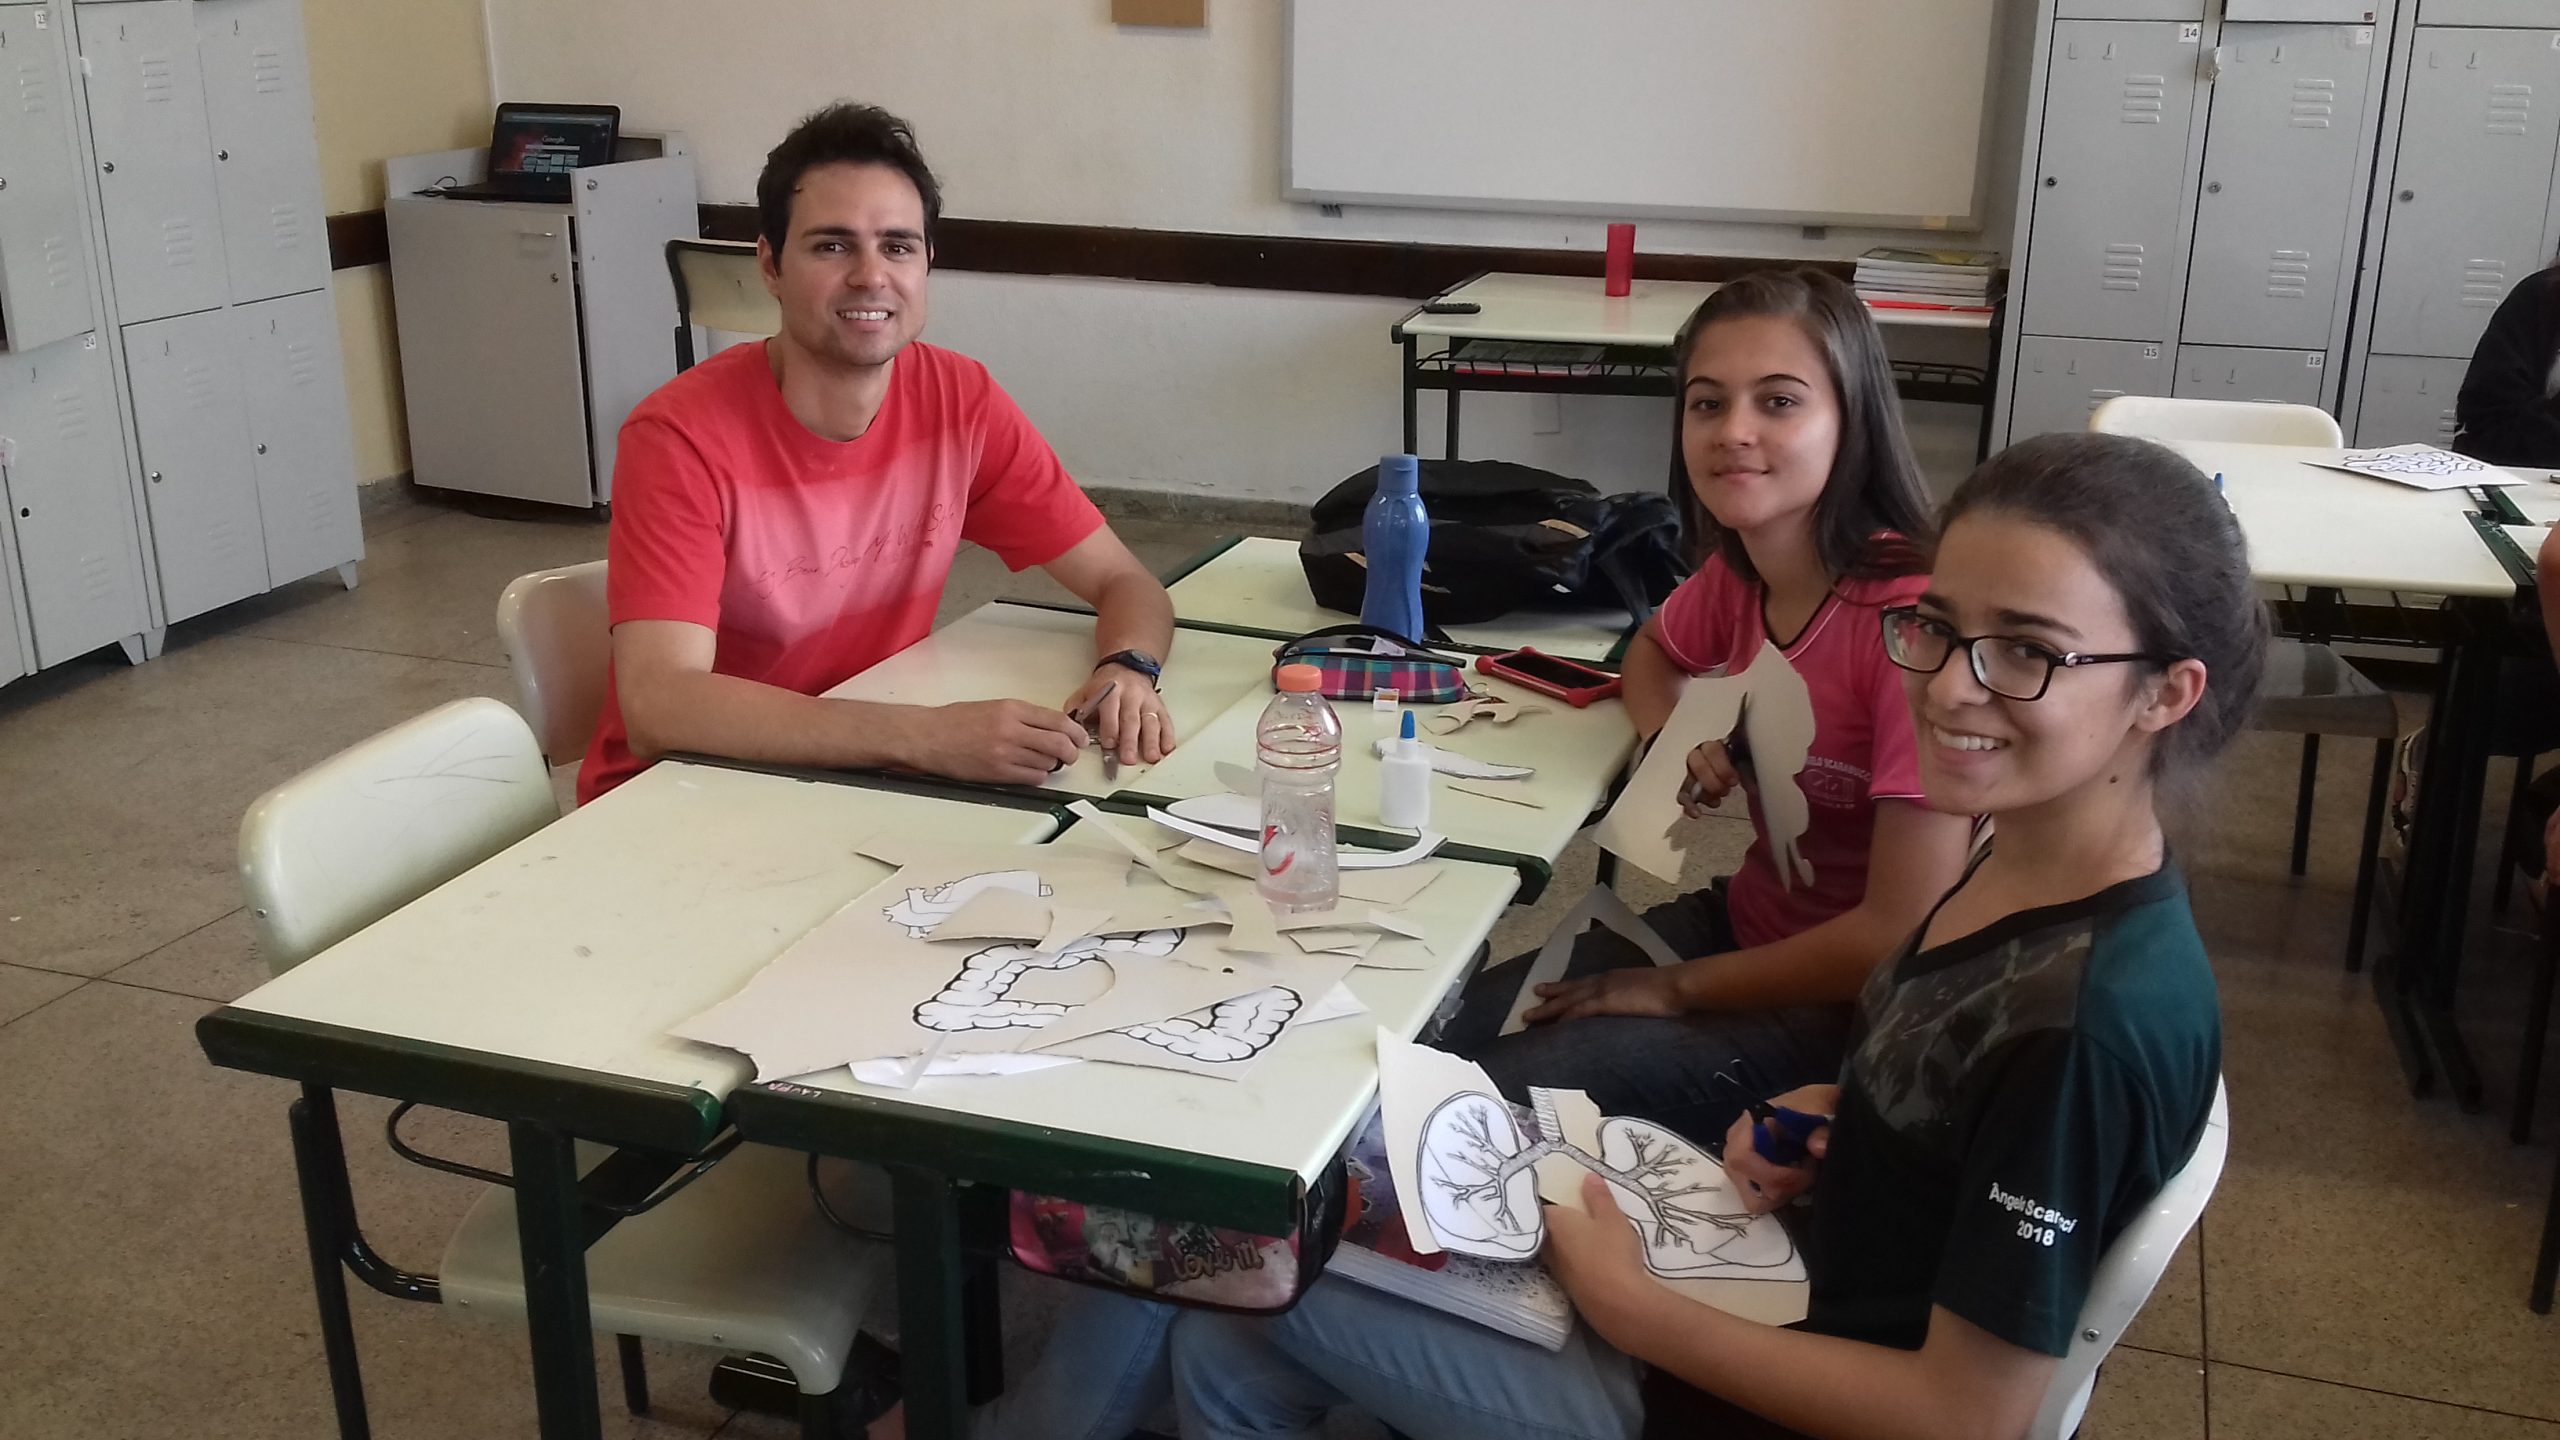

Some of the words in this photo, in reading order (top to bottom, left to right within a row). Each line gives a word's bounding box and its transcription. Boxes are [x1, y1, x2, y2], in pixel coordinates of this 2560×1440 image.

[2183, 28, 2199, 38] 14
[2145, 348, 2158, 357] 15
[2016, 1219, 2056, 1247] 2018
